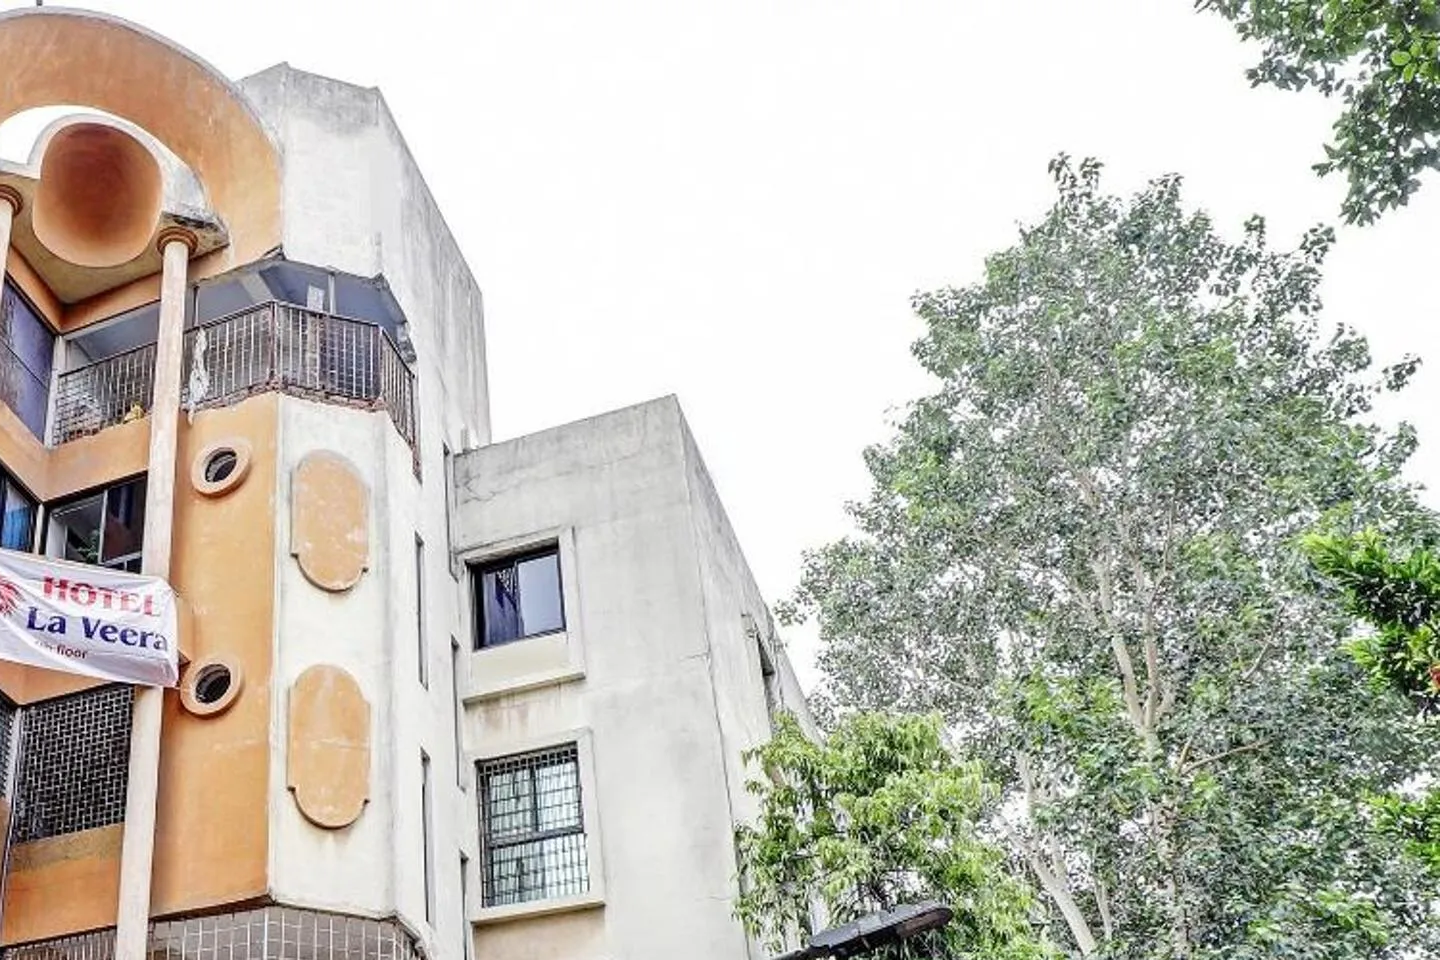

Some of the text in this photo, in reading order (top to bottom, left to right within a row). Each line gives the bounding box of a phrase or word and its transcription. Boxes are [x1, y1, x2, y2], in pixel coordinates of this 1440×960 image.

[43, 575, 161, 618] HOTEL
[26, 606, 168, 651] La Veera
